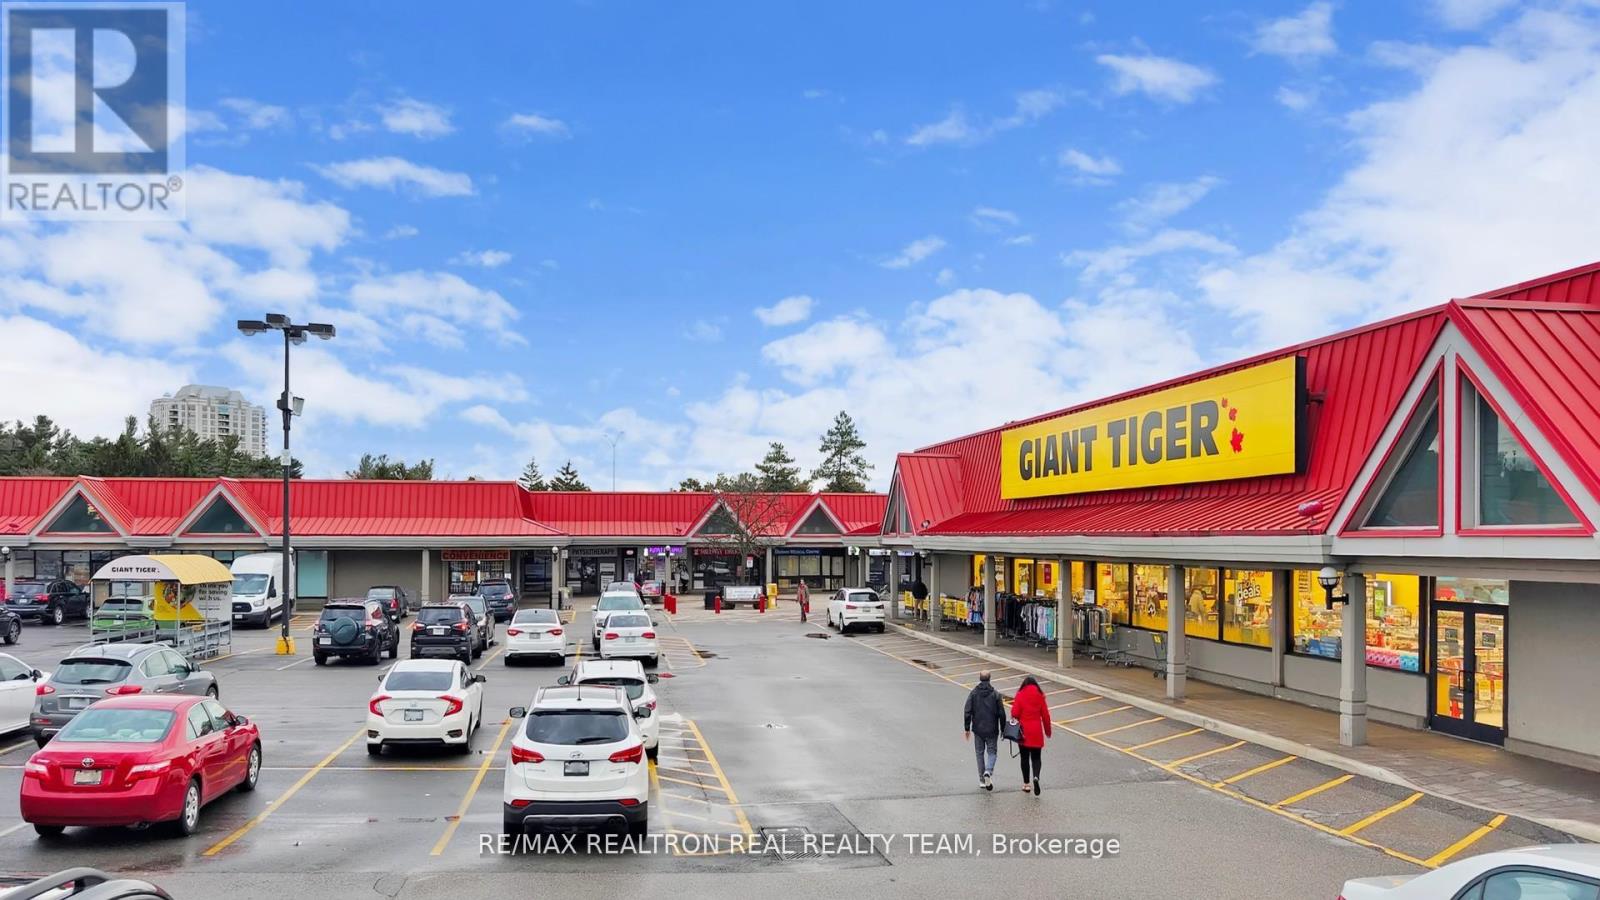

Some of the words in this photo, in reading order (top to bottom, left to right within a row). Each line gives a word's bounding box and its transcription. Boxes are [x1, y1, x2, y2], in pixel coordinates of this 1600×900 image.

[1019, 425, 1097, 481] GIANT
[1107, 399, 1220, 468] TIGER
[1236, 583, 1261, 600] deals
